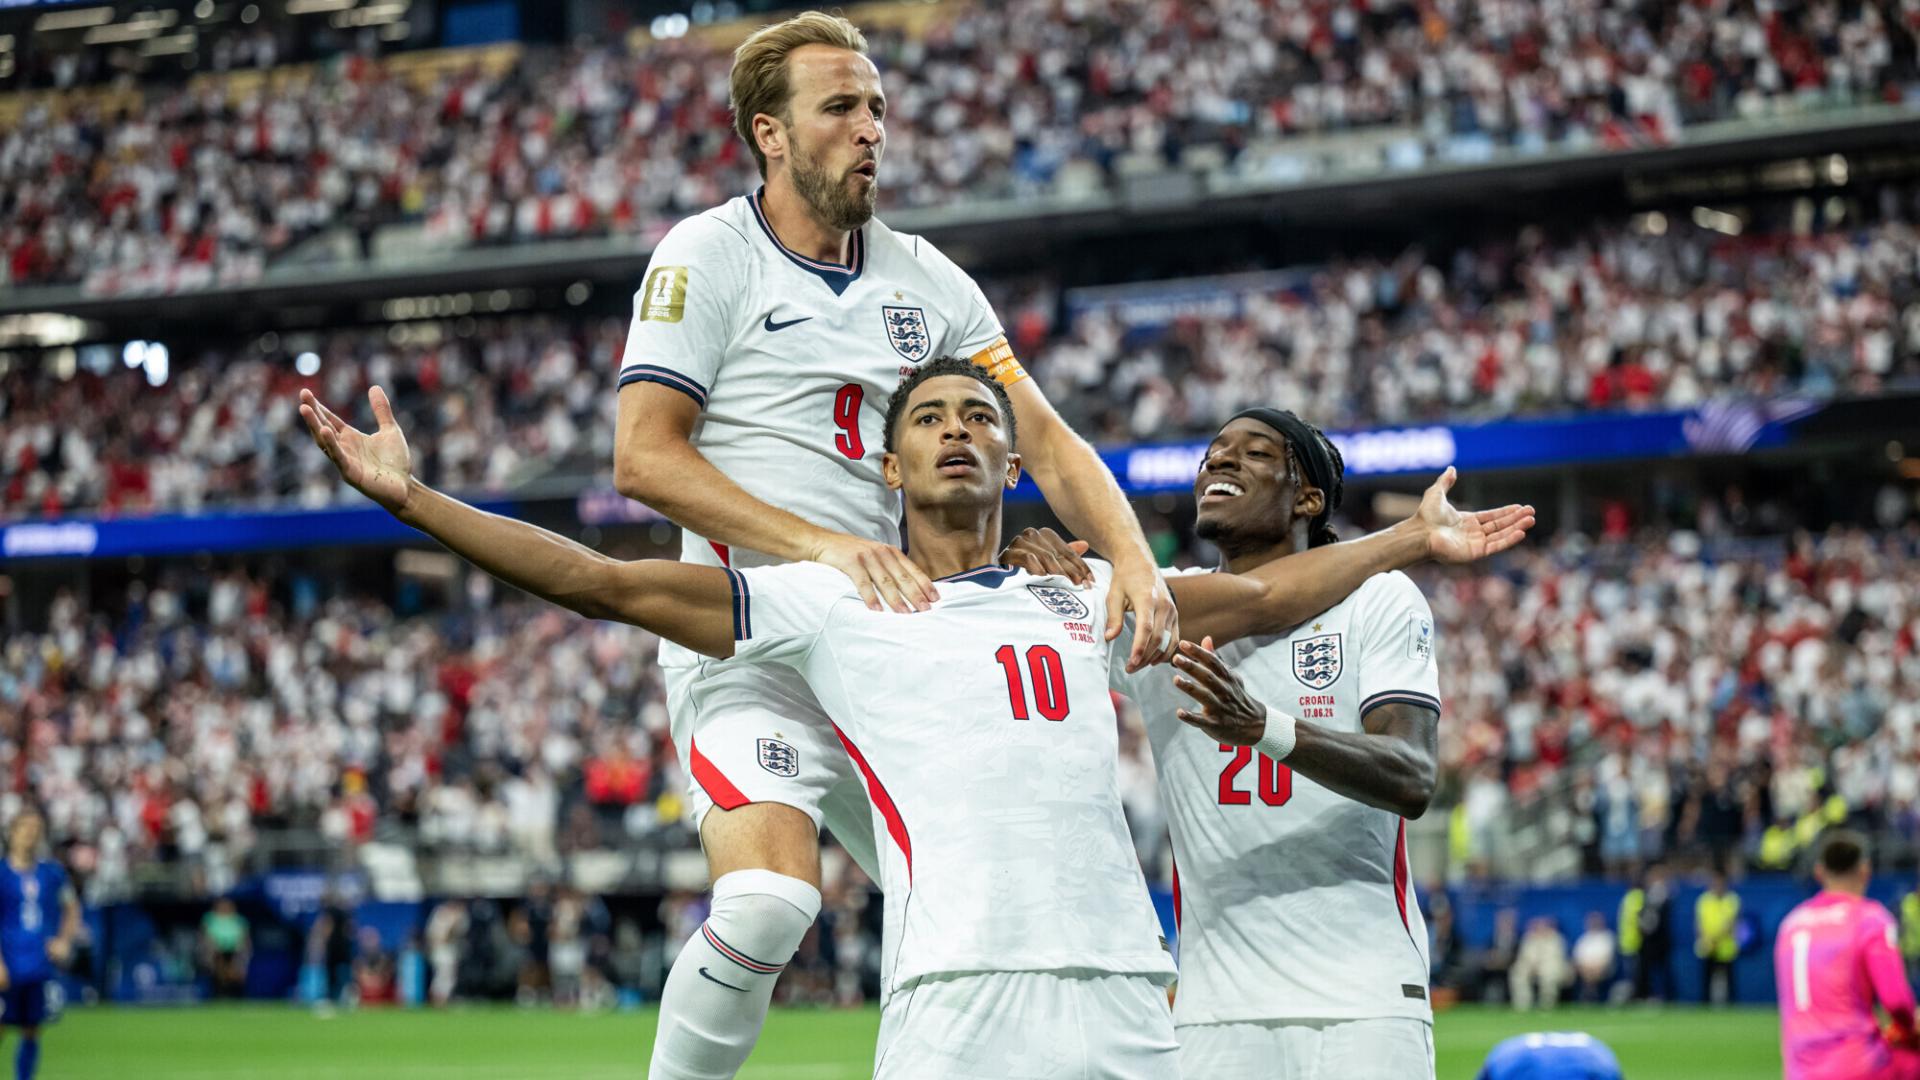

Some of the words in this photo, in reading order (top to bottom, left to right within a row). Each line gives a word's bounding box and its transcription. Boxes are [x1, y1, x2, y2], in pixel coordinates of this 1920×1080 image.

[834, 383, 865, 460] 9
[995, 644, 1070, 721] 10
[1299, 695, 1335, 706] CROATIA
[1303, 707, 1334, 718] 17.06.26
[1218, 742, 1292, 807] 20
[1792, 931, 1812, 1012] 1
